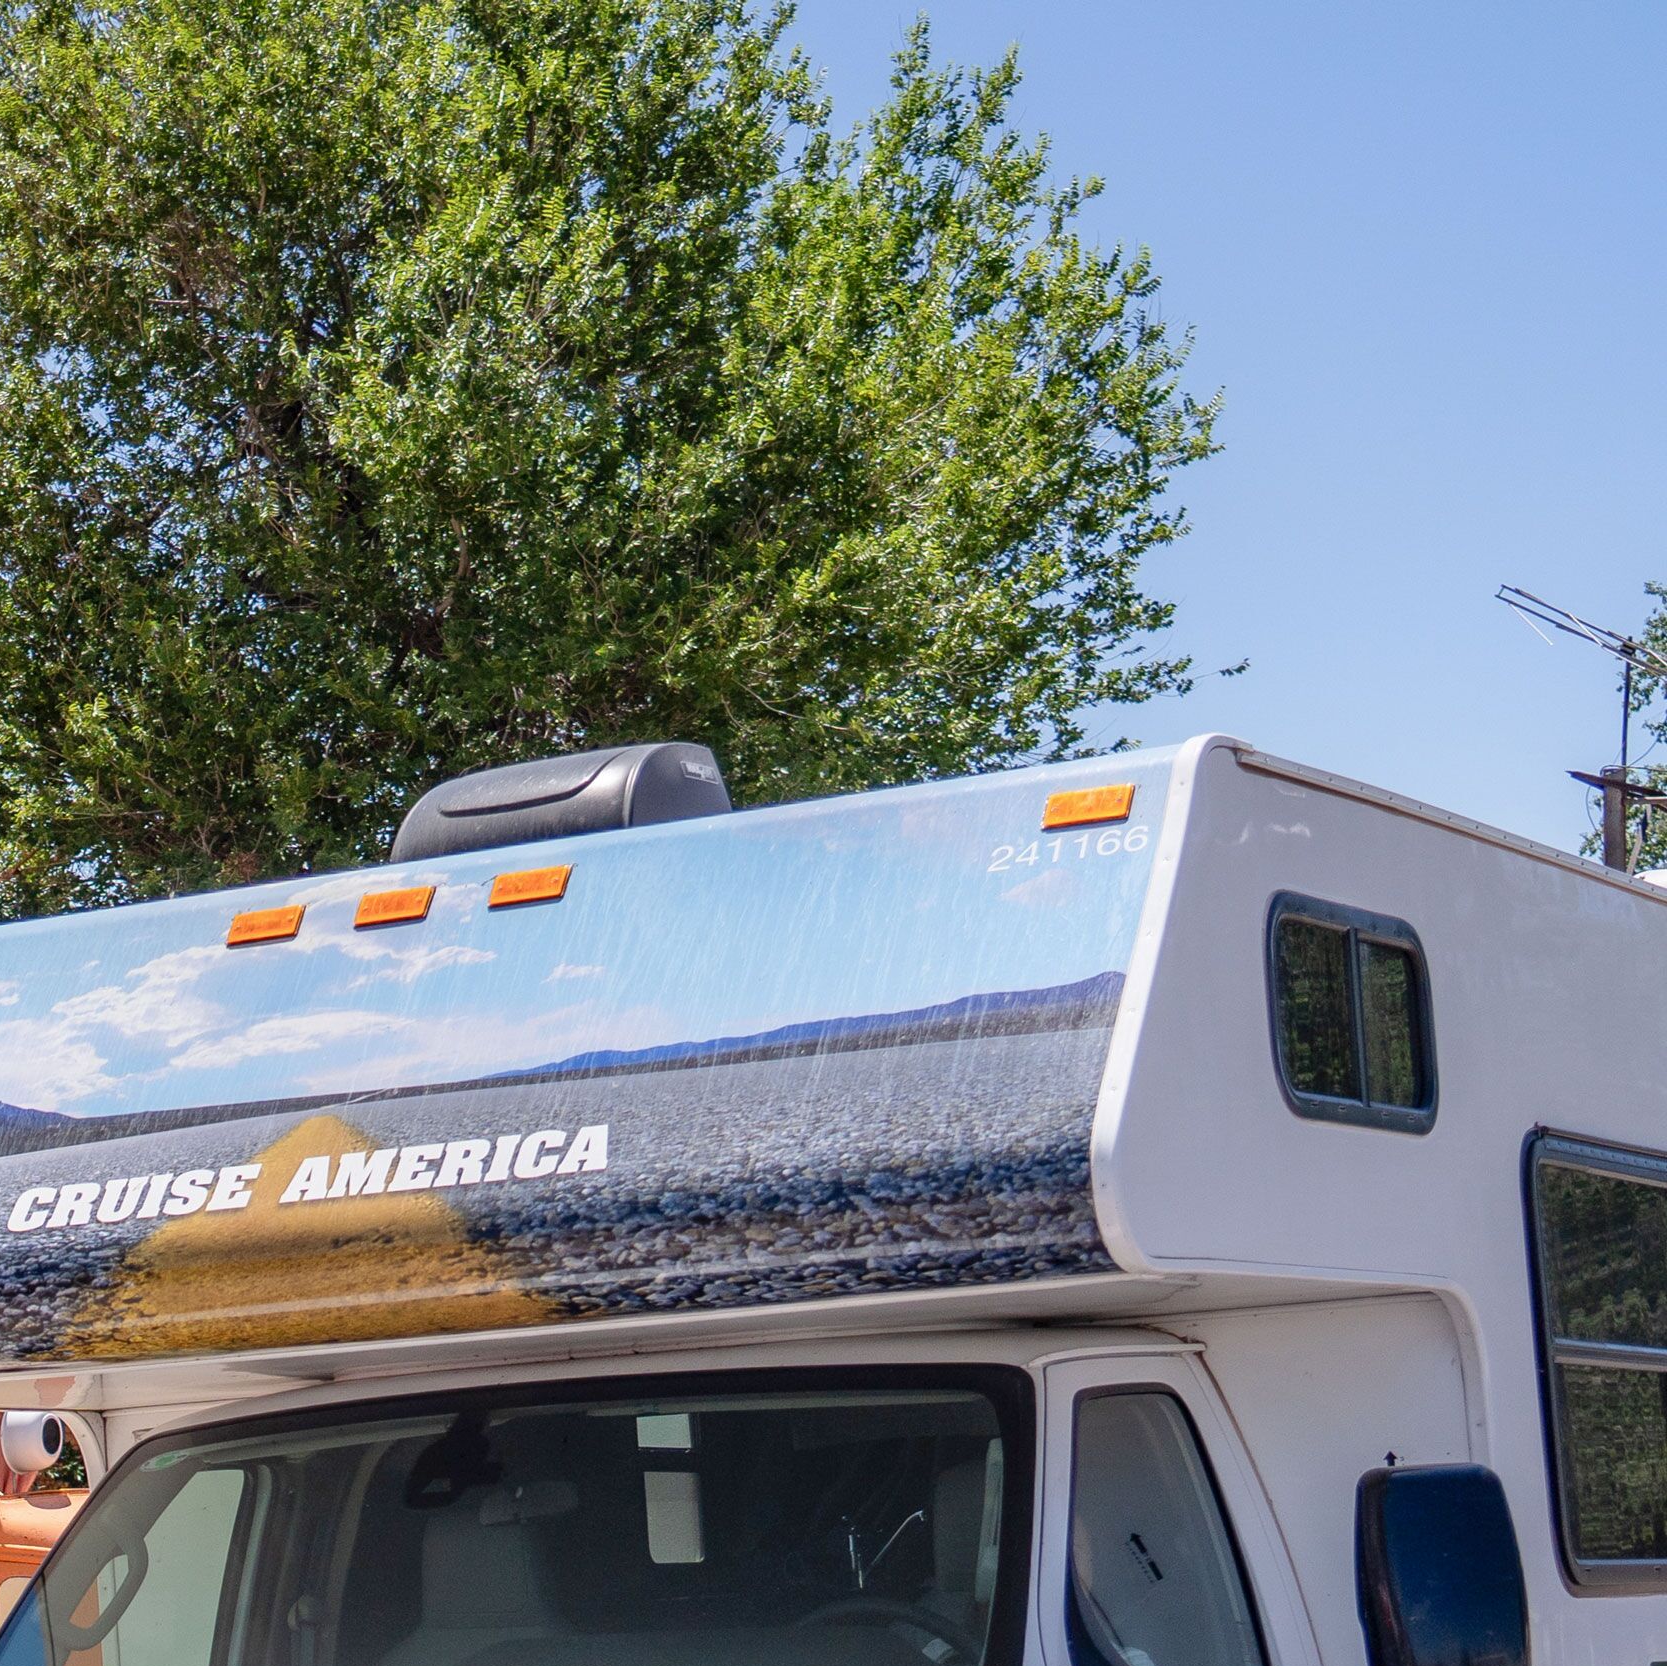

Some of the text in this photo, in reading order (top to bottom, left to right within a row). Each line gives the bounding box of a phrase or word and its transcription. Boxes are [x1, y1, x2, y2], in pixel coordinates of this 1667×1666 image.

[987, 825, 1149, 872] 241166
[6, 1124, 609, 1233] CRUISE AMERICA
